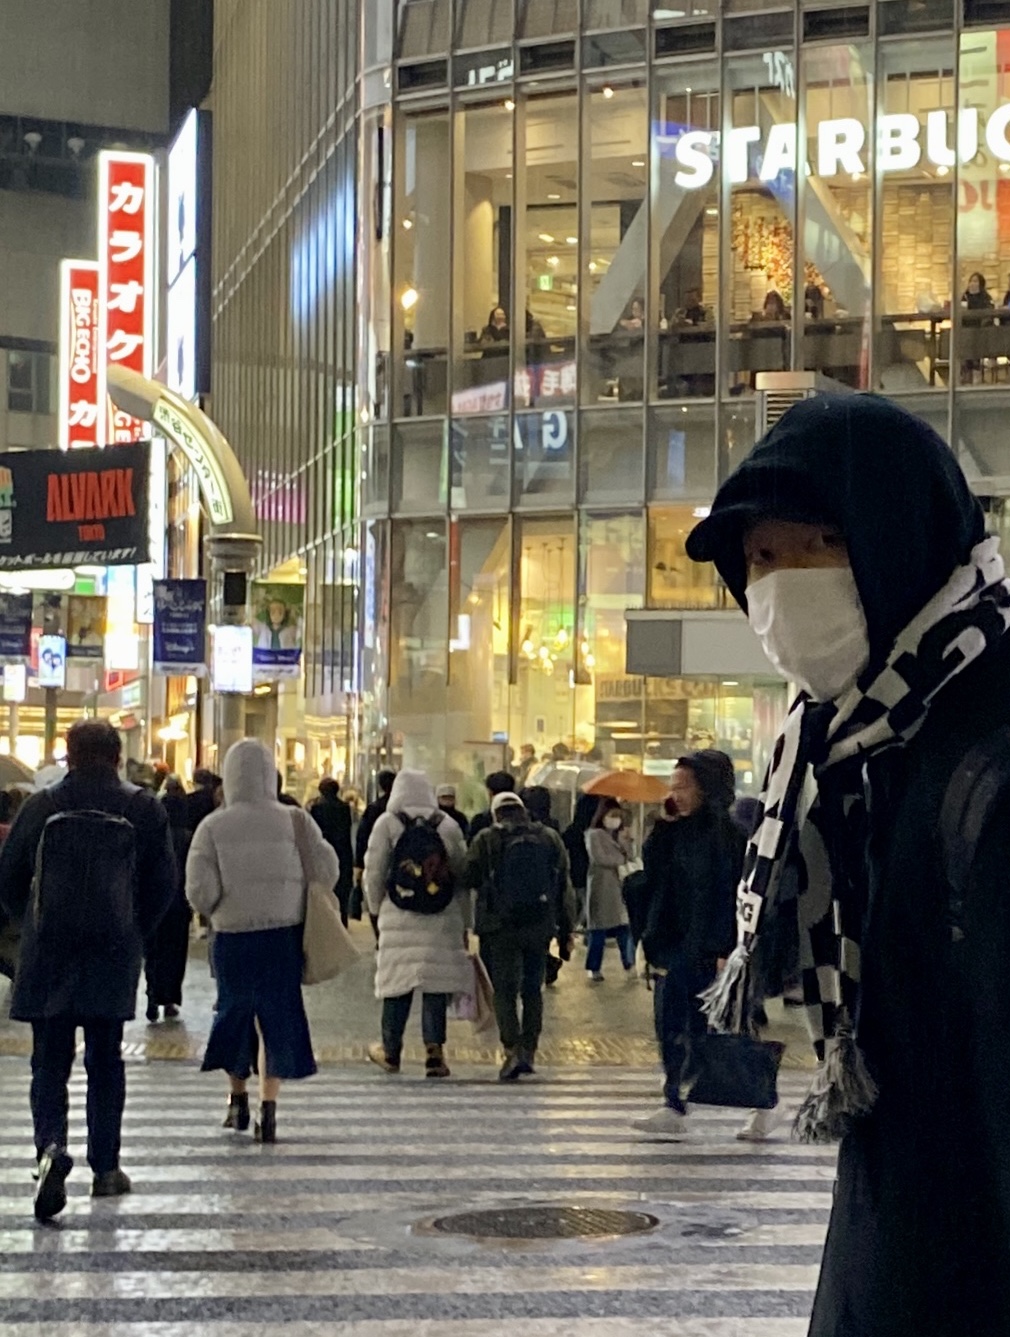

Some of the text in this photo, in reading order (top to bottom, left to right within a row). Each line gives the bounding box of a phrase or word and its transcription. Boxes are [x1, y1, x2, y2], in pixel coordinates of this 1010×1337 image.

[107, 182, 144, 361] カラオケ
[70, 288, 93, 384] BIG ECHO
[46, 468, 136, 522] ALVARK
